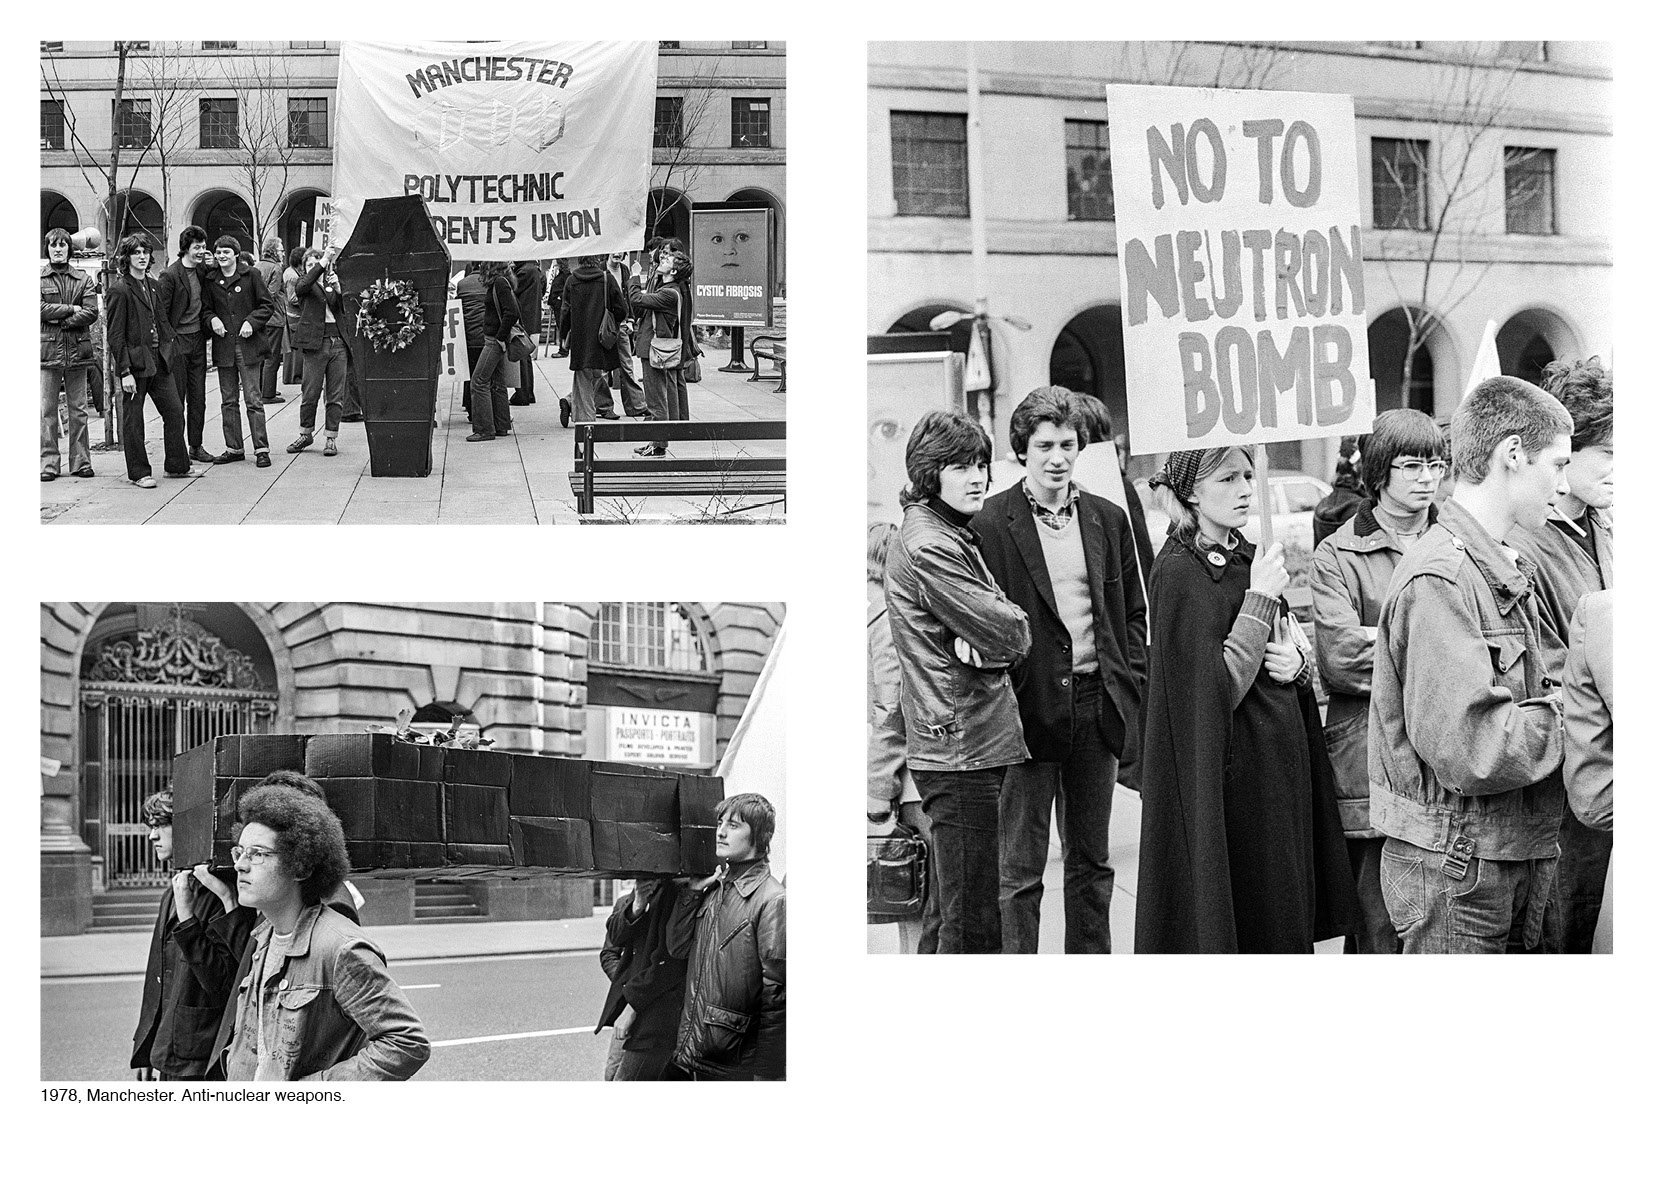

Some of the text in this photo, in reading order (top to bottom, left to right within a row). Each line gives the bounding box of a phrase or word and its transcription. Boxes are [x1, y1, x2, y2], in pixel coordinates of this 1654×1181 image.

[405, 56, 574, 99] MANCHESTER
[1146, 117, 1322, 210] NO TO
[403, 172, 565, 204] POLYTECHNIC
[431, 207, 602, 245] DENTS UNION
[696, 285, 763, 300] CYSTIC FIBROSIS
[1124, 224, 1366, 328] NEUTRON
[1178, 324, 1357, 439] BOMB
[616, 727, 654, 740] PASSPORTS
[661, 729, 695, 743] PORTRAITS
[621, 712, 691, 728] INVICTA
